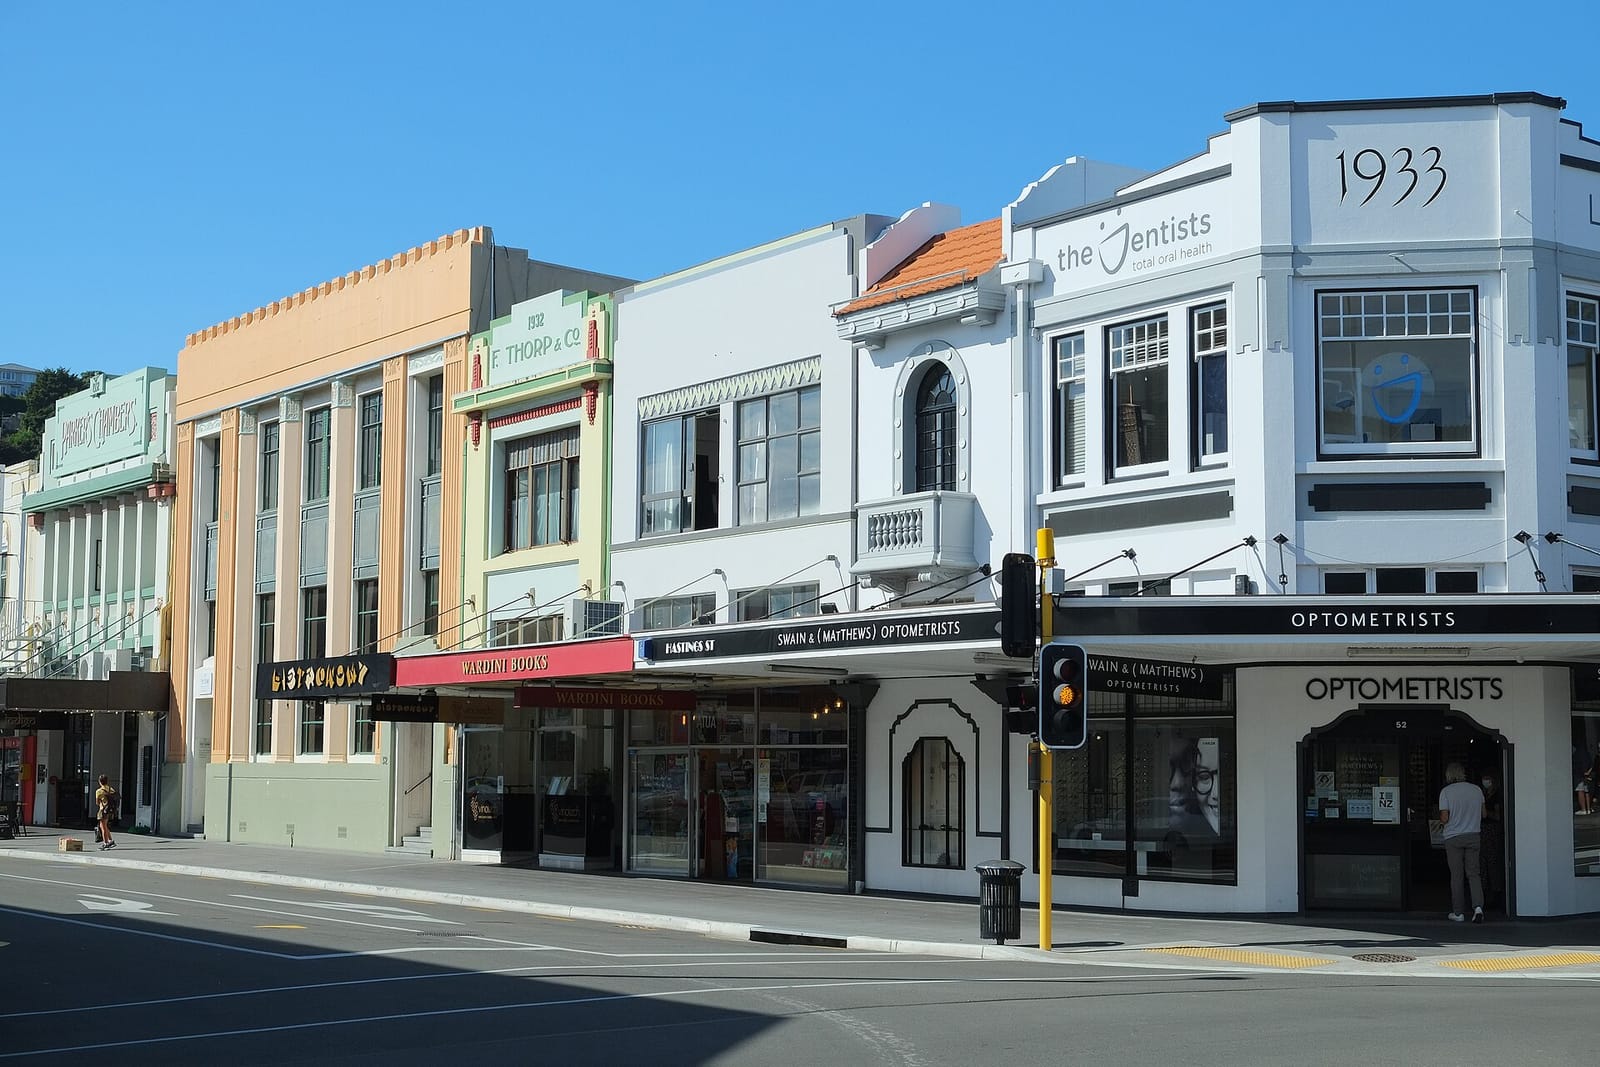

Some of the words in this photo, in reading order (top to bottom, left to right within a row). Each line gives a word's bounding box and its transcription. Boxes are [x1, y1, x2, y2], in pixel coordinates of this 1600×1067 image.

[1335, 145, 1448, 208] 1933
[1057, 243, 1094, 272] the
[1132, 255, 1156, 272] total
[1158, 249, 1177, 265] oral
[1180, 241, 1213, 260] health
[527, 311, 545, 331] 1932
[506, 335, 552, 365] THORP
[553, 337, 562, 351] &
[61, 411, 93, 460] PARKER'S
[93, 398, 138, 449] CHAMBERS
[1291, 612, 1456, 628] OPTOMETRISTS
[777, 631, 807, 647] SWAIN
[808, 633, 815, 644] &
[881, 620, 961, 640] OPTOMETRISTS
[665, 640, 704, 655] HASTINGS
[704, 639, 716, 652] ST
[461, 657, 507, 676] WARDINI
[511, 654, 549, 672] BOOKS
[1087, 657, 1119, 673] WAIN
[1121, 663, 1130, 674] &
[1106, 679, 1181, 693] OPTOMETRISTS
[1305, 677, 1504, 701] OPTOMETRISTS
[554, 691, 616, 707] WARDINI
[620, 693, 664, 707] BOOKS
[1396, 721, 1407, 729] 52
